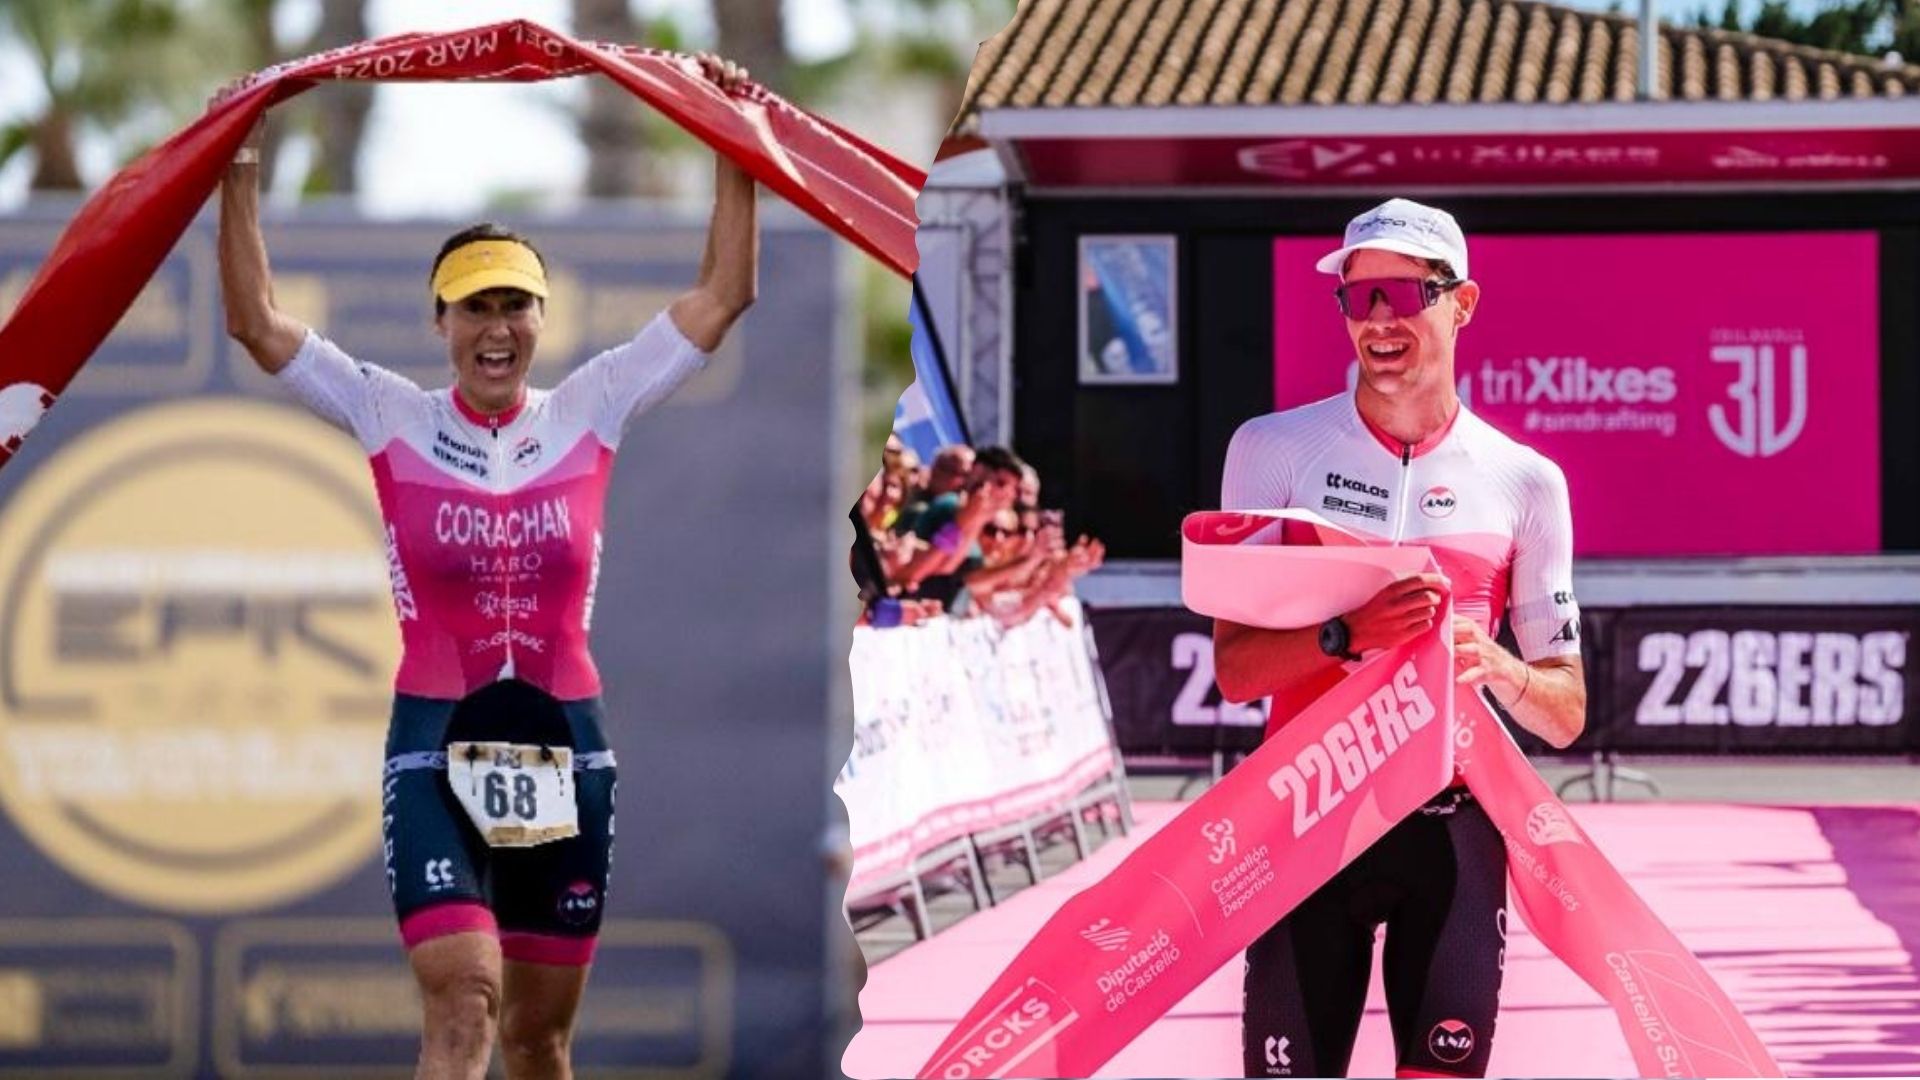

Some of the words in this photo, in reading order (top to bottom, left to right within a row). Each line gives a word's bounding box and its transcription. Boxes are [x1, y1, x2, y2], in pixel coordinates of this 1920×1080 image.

[333, 50, 415, 79] 2024
[425, 32, 498, 66] MAR
[1480, 355, 1677, 404] triXilxes
[435, 497, 571, 548] CORACHAN
[469, 553, 542, 573] HARO
[1635, 629, 1906, 727] 226ERS
[1267, 661, 1436, 839] 226ERS
[484, 771, 538, 821] 68
[1211, 845, 1268, 894] Castellón
[1218, 859, 1270, 905] Escenario
[1223, 871, 1275, 918] Deportivo
[1096, 928, 1170, 993] Diputació
[1106, 991, 1126, 1012] de
[1124, 943, 1180, 996] Castelló
[1606, 952, 1665, 1042] Castelló
